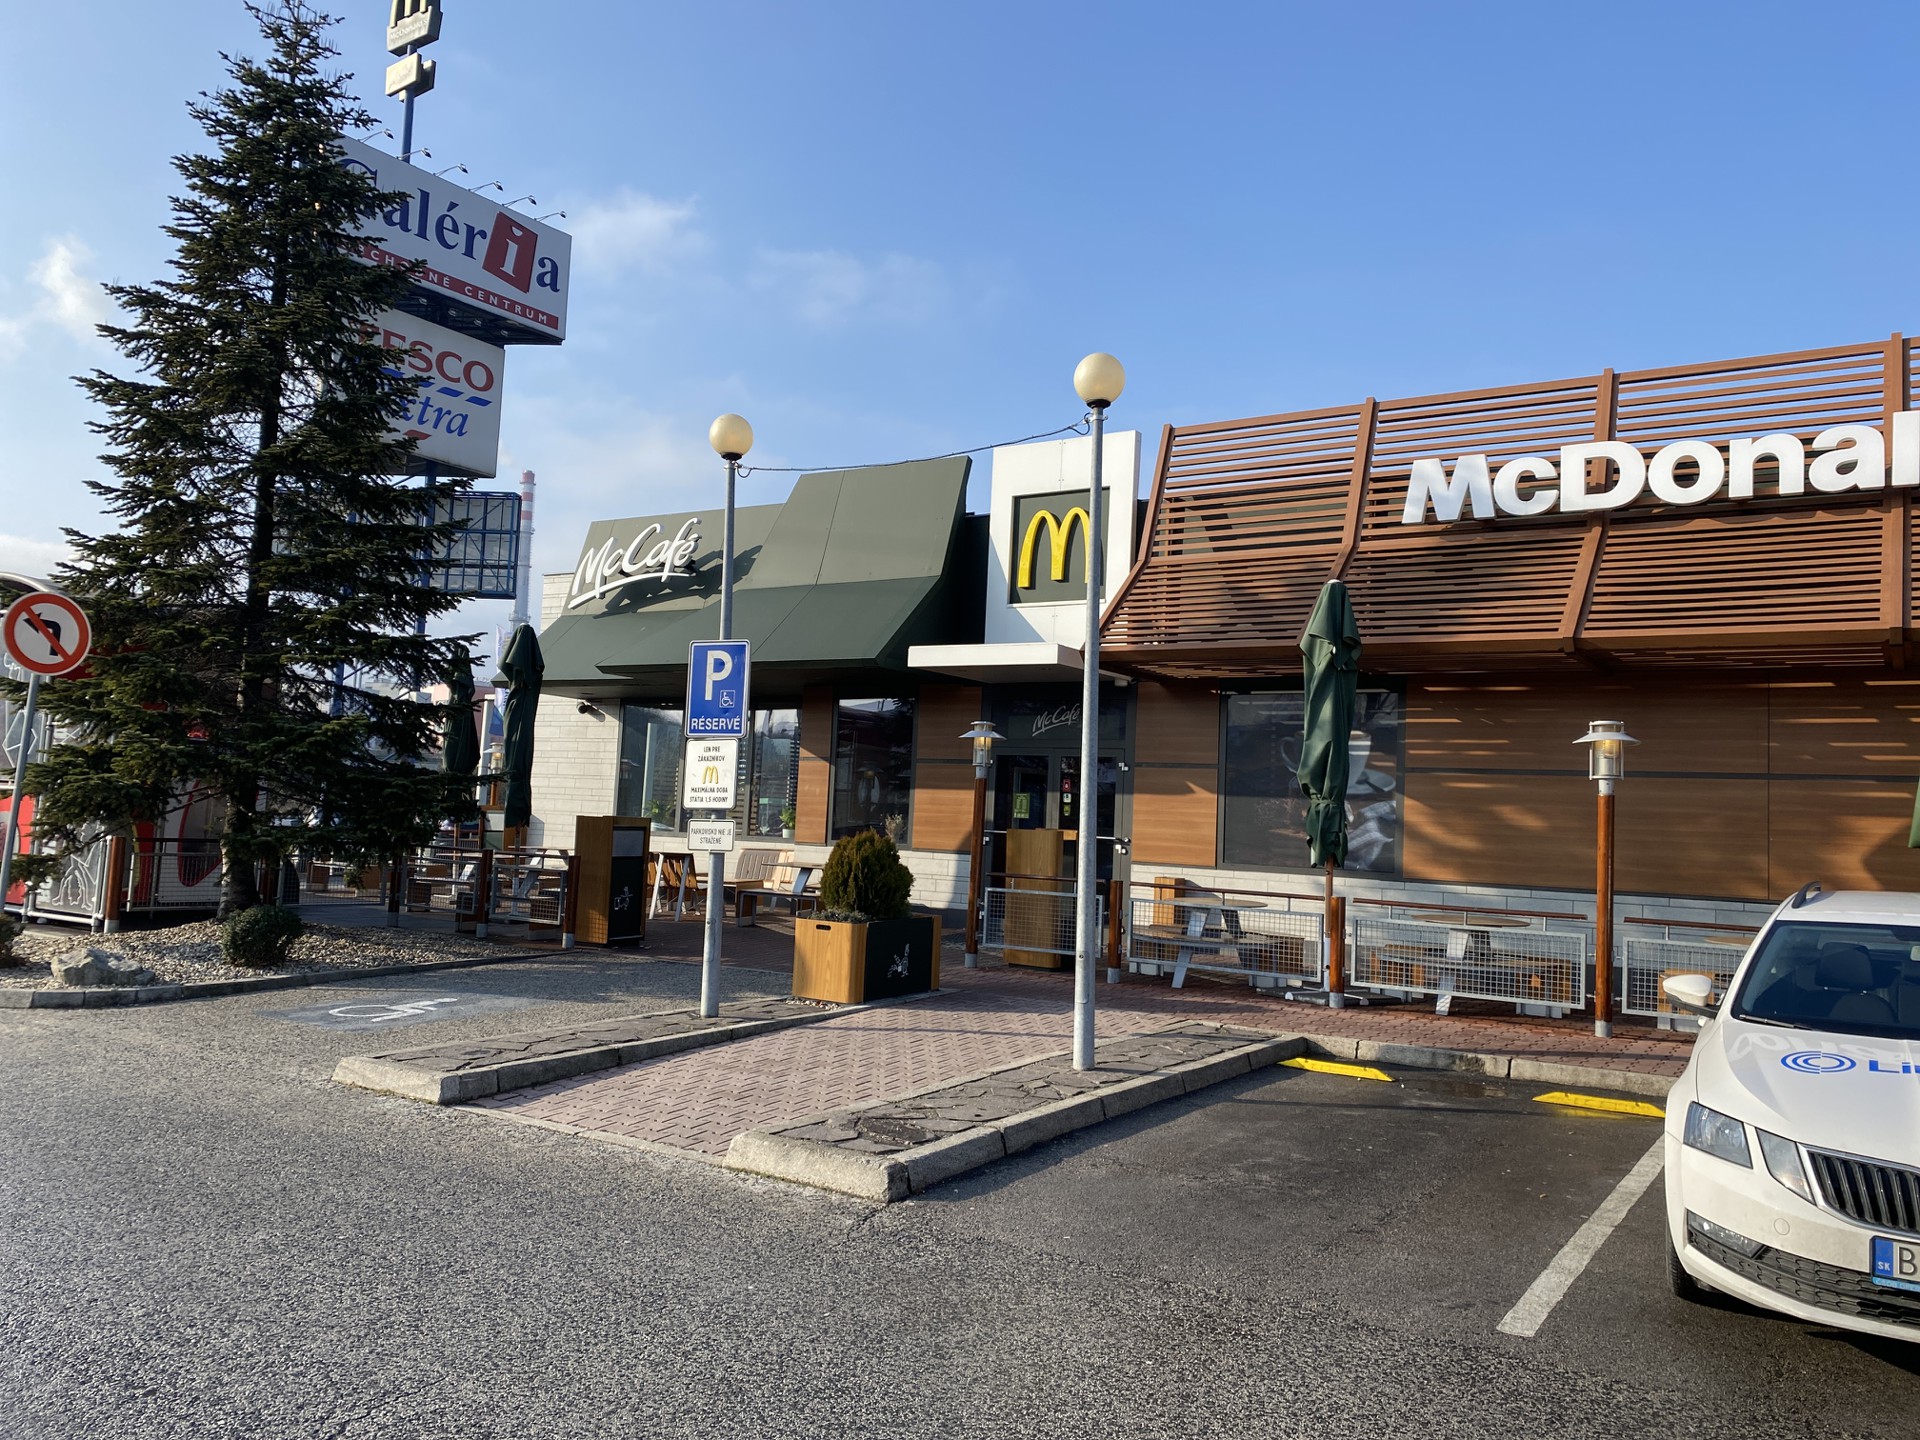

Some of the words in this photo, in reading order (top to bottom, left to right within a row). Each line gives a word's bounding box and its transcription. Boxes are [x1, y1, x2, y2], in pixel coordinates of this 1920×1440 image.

[464, 285, 548, 325] CENTRUM
[570, 517, 699, 600] McCafé
[704, 650, 733, 701] P
[690, 716, 741, 731] RÉSERVÉ
[1868, 1059, 1920, 1075] Li
[1877, 1261, 1891, 1272] SK
[1898, 1246, 1918, 1276] B
